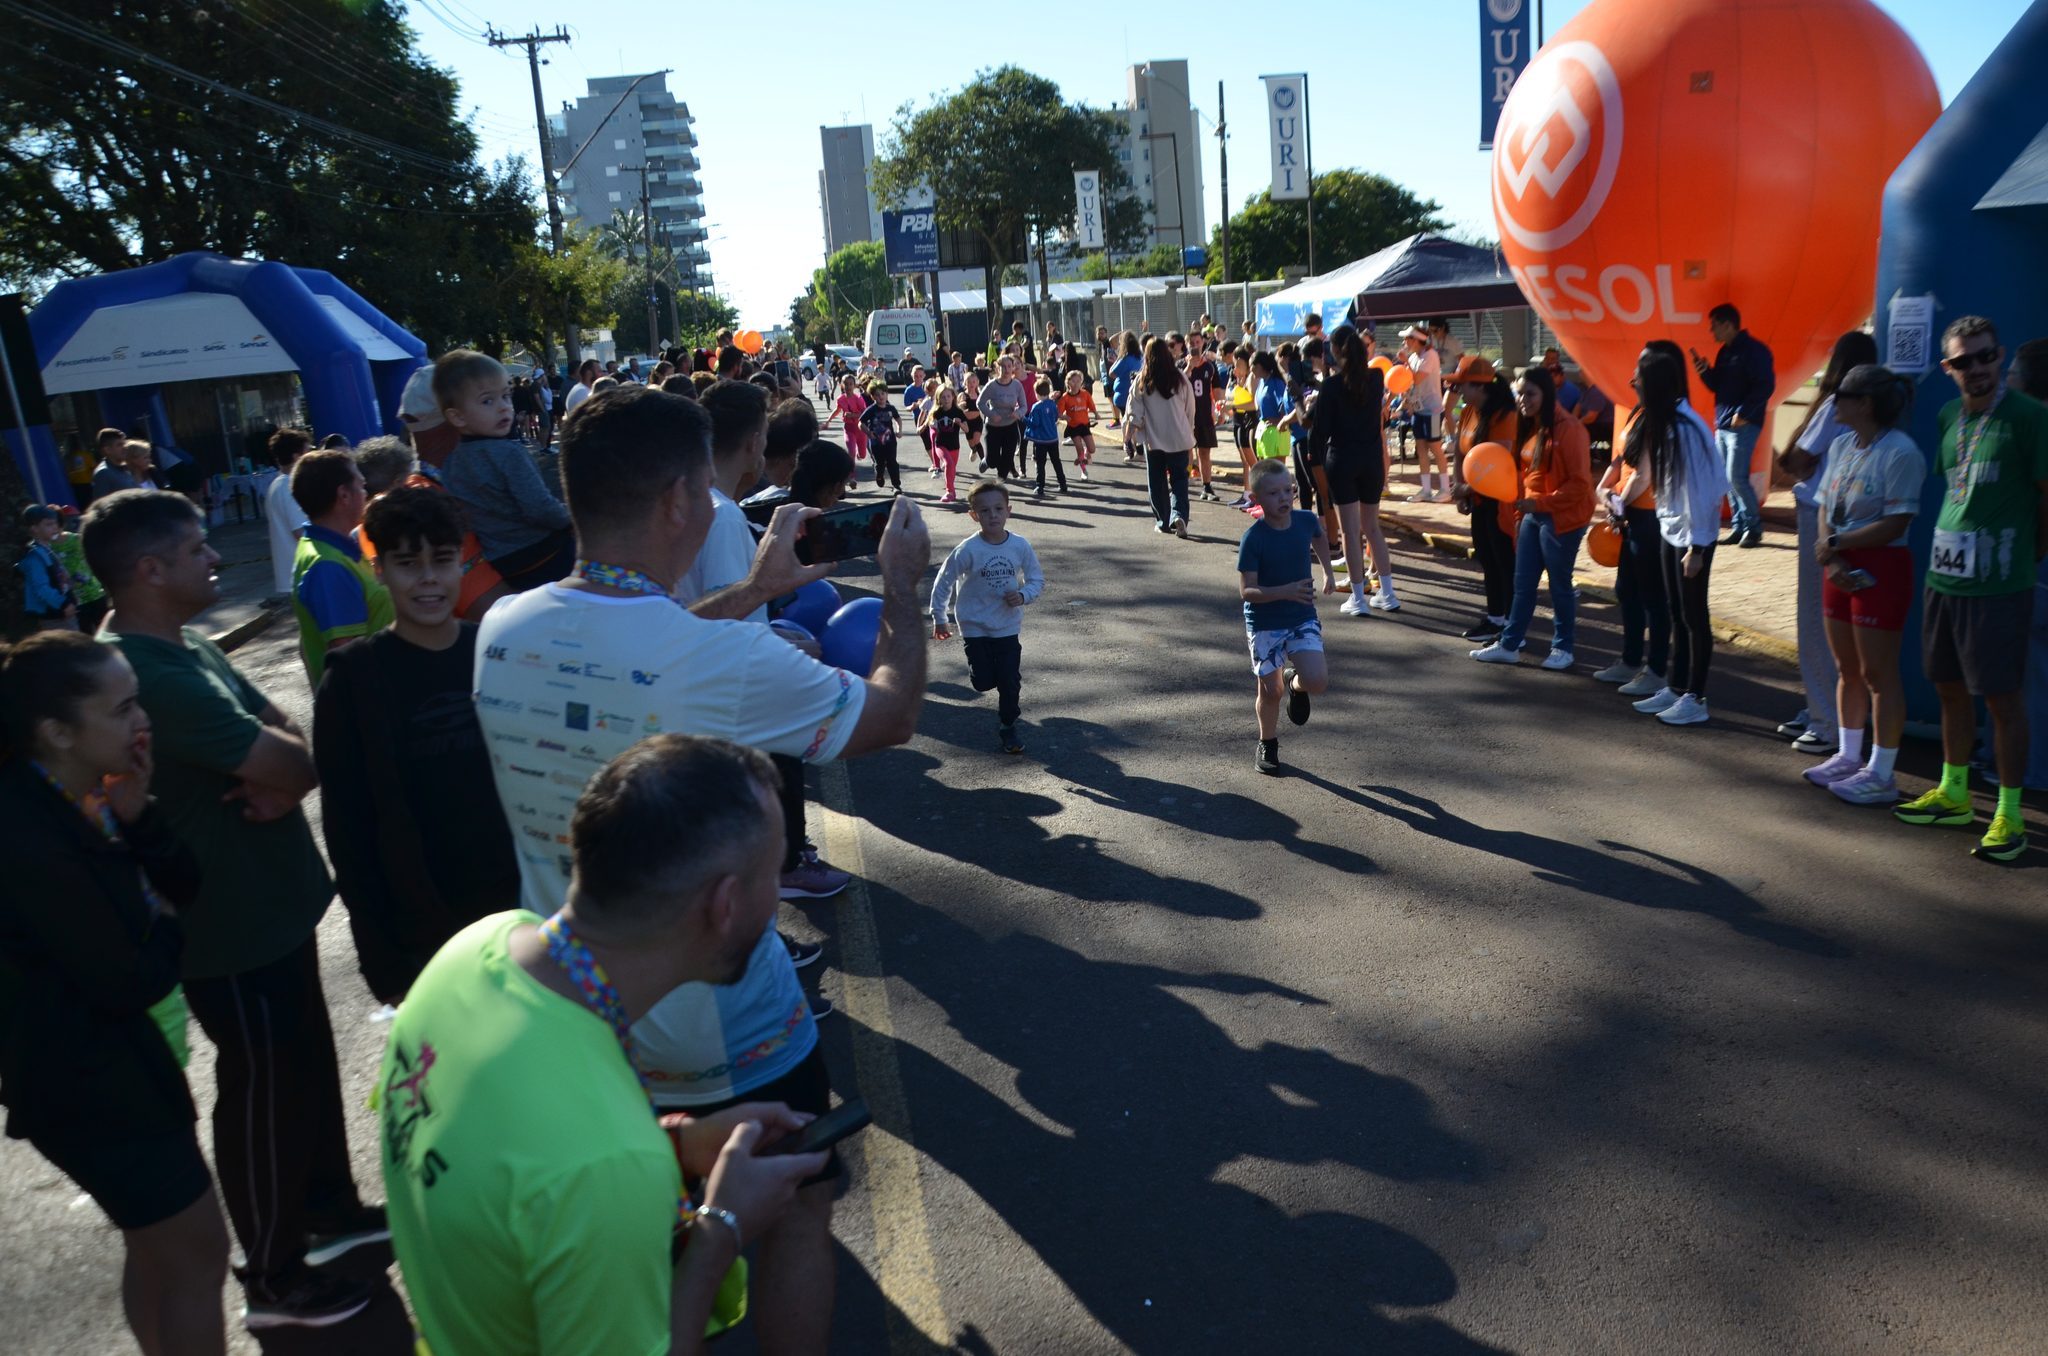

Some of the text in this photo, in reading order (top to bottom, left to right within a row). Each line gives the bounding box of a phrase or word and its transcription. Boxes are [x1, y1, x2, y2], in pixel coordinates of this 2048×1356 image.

[1490, 28, 1520, 109] UR
[1277, 117, 1297, 191] URI
[1083, 196, 1096, 242] URI
[140, 348, 189, 358] Sindicatos
[1194, 379, 1203, 397] 9
[981, 568, 1015, 577] MOUNTAINS
